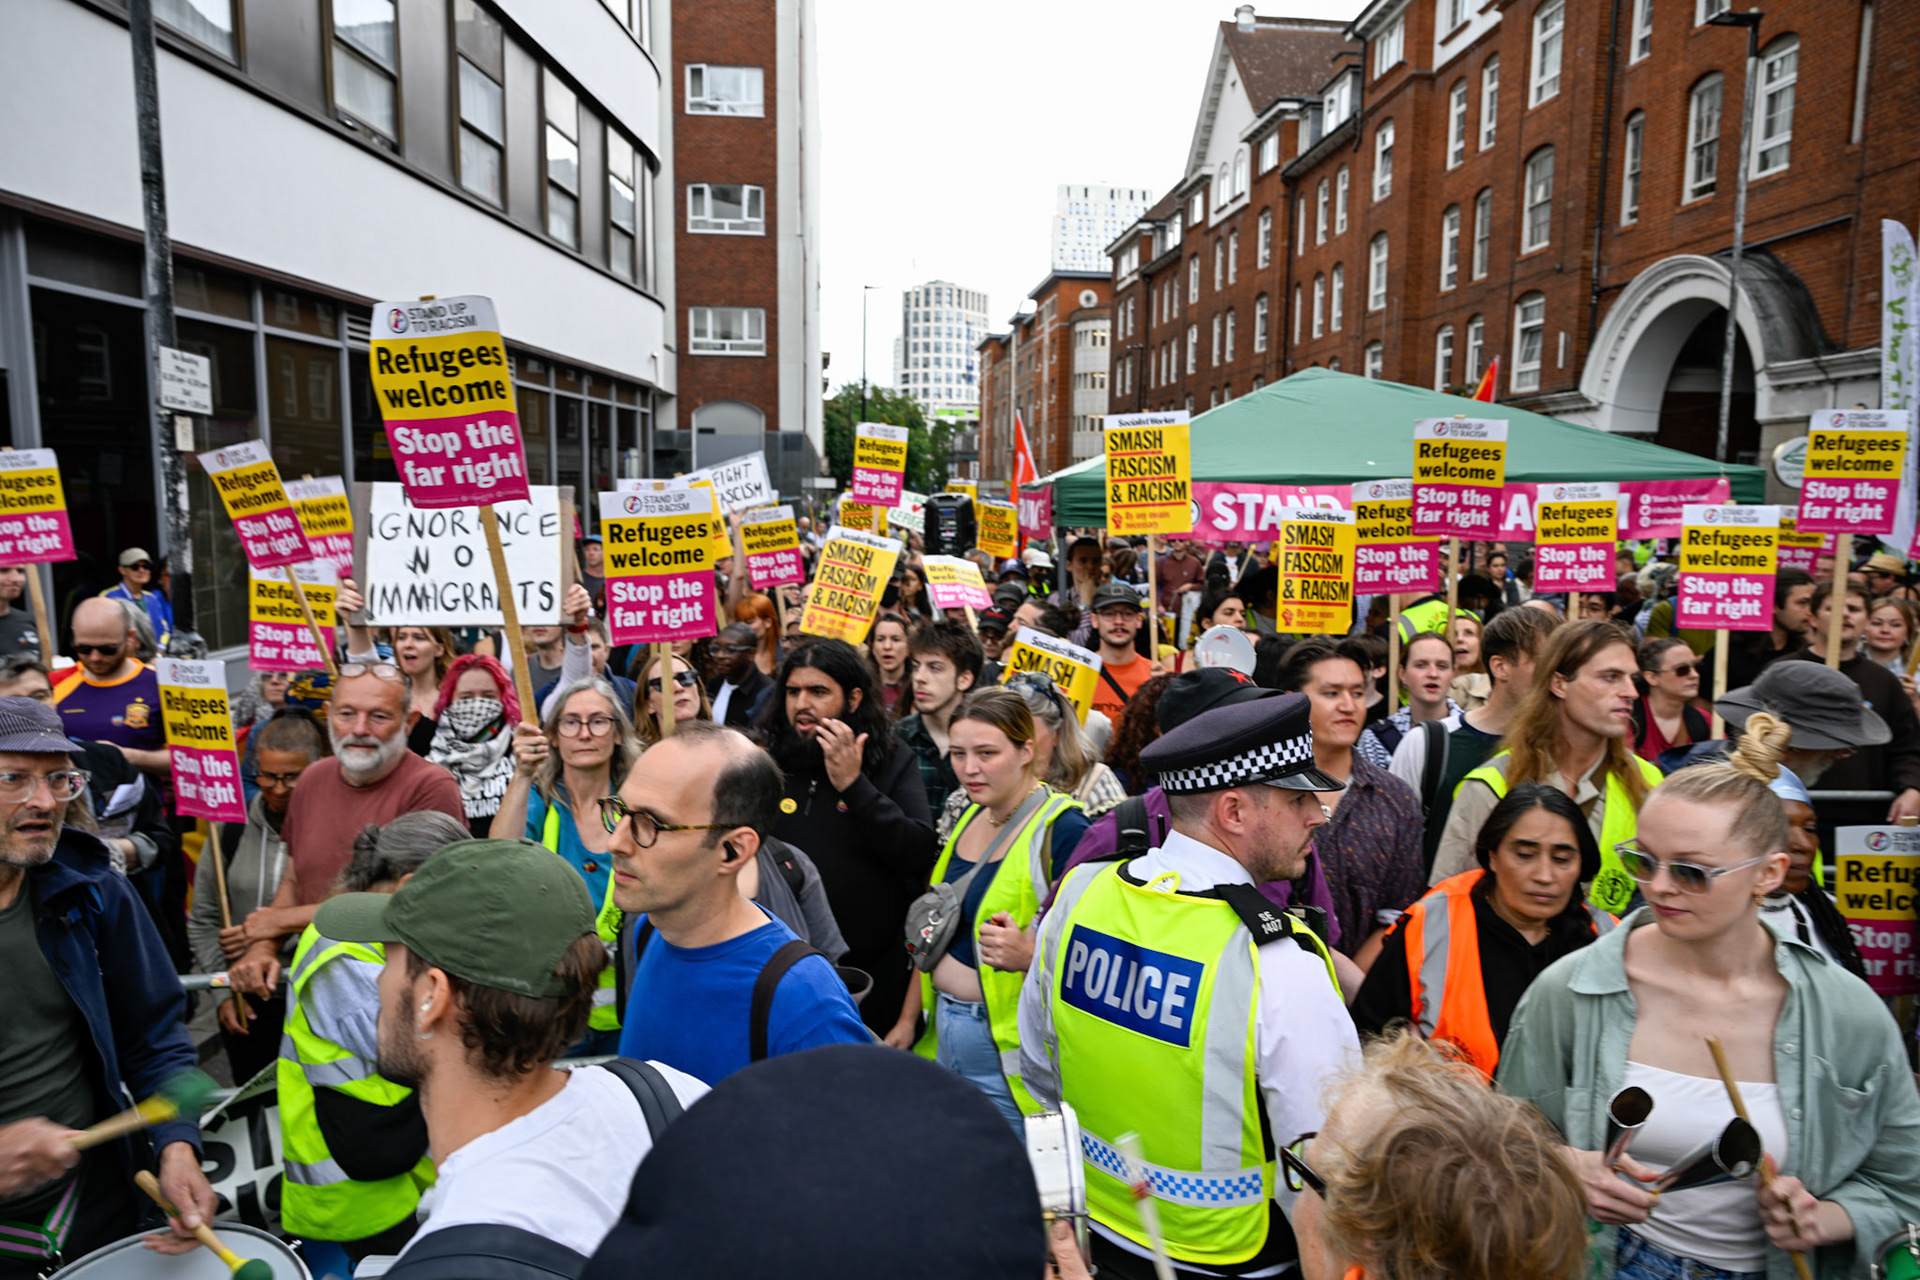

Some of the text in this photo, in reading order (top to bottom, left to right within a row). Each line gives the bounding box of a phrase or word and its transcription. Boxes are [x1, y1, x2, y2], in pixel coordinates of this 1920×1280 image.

[408, 303, 467, 319] STAND UP
[411, 315, 478, 332] TO RACISM
[376, 345, 503, 378] Refugees
[383, 379, 507, 408] welcome
[1118, 417, 1176, 427] Socialist Worker
[1450, 422, 1473, 430] STAND
[393, 419, 516, 458] Stop the
[859, 439, 904, 455] Refugees
[1109, 430, 1163, 451] SMASH
[1813, 434, 1901, 454] Refugees
[858, 453, 900, 467] welcome
[1419, 442, 1502, 463] Refugees
[404, 452, 522, 488] far right
[1110, 455, 1176, 477] FASCISM
[1418, 462, 1496, 480] welcome
[1811, 455, 1894, 472] welcome
[216, 468, 277, 493] Refugees
[712, 463, 752, 488] FIGHT
[855, 469, 898, 485] Stop the
[228, 489, 283, 511] welcome
[644, 494, 685, 504] STAND UP
[720, 482, 763, 510] ASCISM
[854, 482, 870, 495] far
[871, 485, 896, 499] right
[1111, 481, 1187, 503] & RACISM
[1416, 487, 1458, 508] Stop
[1461, 489, 1492, 507] the
[1804, 481, 1888, 502] Stop the
[296, 501, 346, 516] efugees
[644, 503, 690, 513] TO RACISM
[1296, 511, 1346, 522] Socialist Worker
[1357, 504, 1413, 522] Refuge
[1416, 506, 1444, 523] far
[1446, 508, 1490, 528] right
[1542, 505, 1613, 523] Refugees
[1802, 502, 1883, 523] far right
[26, 515, 59, 532] the
[238, 513, 295, 539] Stop the
[302, 516, 347, 531] elcome
[369, 510, 562, 541] IGNORNCE
[743, 522, 794, 538] Refugees
[842, 515, 872, 528] FASCIS
[1357, 522, 1412, 538] welco
[1541, 523, 1609, 538] welcome
[16, 533, 62, 555] right
[248, 538, 270, 557] far
[270, 531, 303, 556] right
[608, 522, 708, 546] Refugees
[746, 536, 794, 550] welcome
[1285, 525, 1335, 546] SMASH
[1687, 529, 1774, 550] Refugees
[405, 541, 513, 577] NO
[610, 547, 704, 568] welcome
[748, 552, 796, 569] Stop the
[826, 541, 875, 568] SMASH
[1284, 552, 1343, 574] FASCISM
[1356, 545, 1430, 567] Stop the
[1539, 546, 1607, 565] Stop the
[1686, 550, 1768, 567] welcome
[751, 564, 798, 581] far right
[819, 564, 877, 594] FASCISM
[1356, 563, 1428, 585] far right
[1538, 564, 1606, 583] far right
[611, 578, 703, 605] Stop the
[1283, 579, 1349, 601] & RACISM
[1683, 576, 1764, 599] Stop the
[367, 580, 554, 620] IMMIGRATS
[812, 588, 877, 617] & RACISM
[1682, 596, 1762, 620] far right
[613, 602, 703, 629] far right
[254, 624, 294, 645] Stop
[254, 643, 279, 658] far
[1068, 649, 1092, 664] Worker
[1013, 648, 1076, 688] SMASH
[202, 755, 233, 777] the
[177, 776, 197, 799] far
[1258, 911, 1275, 921] SE
[1261, 919, 1283, 935] 1407
[1065, 940, 1192, 1029] POLICE
